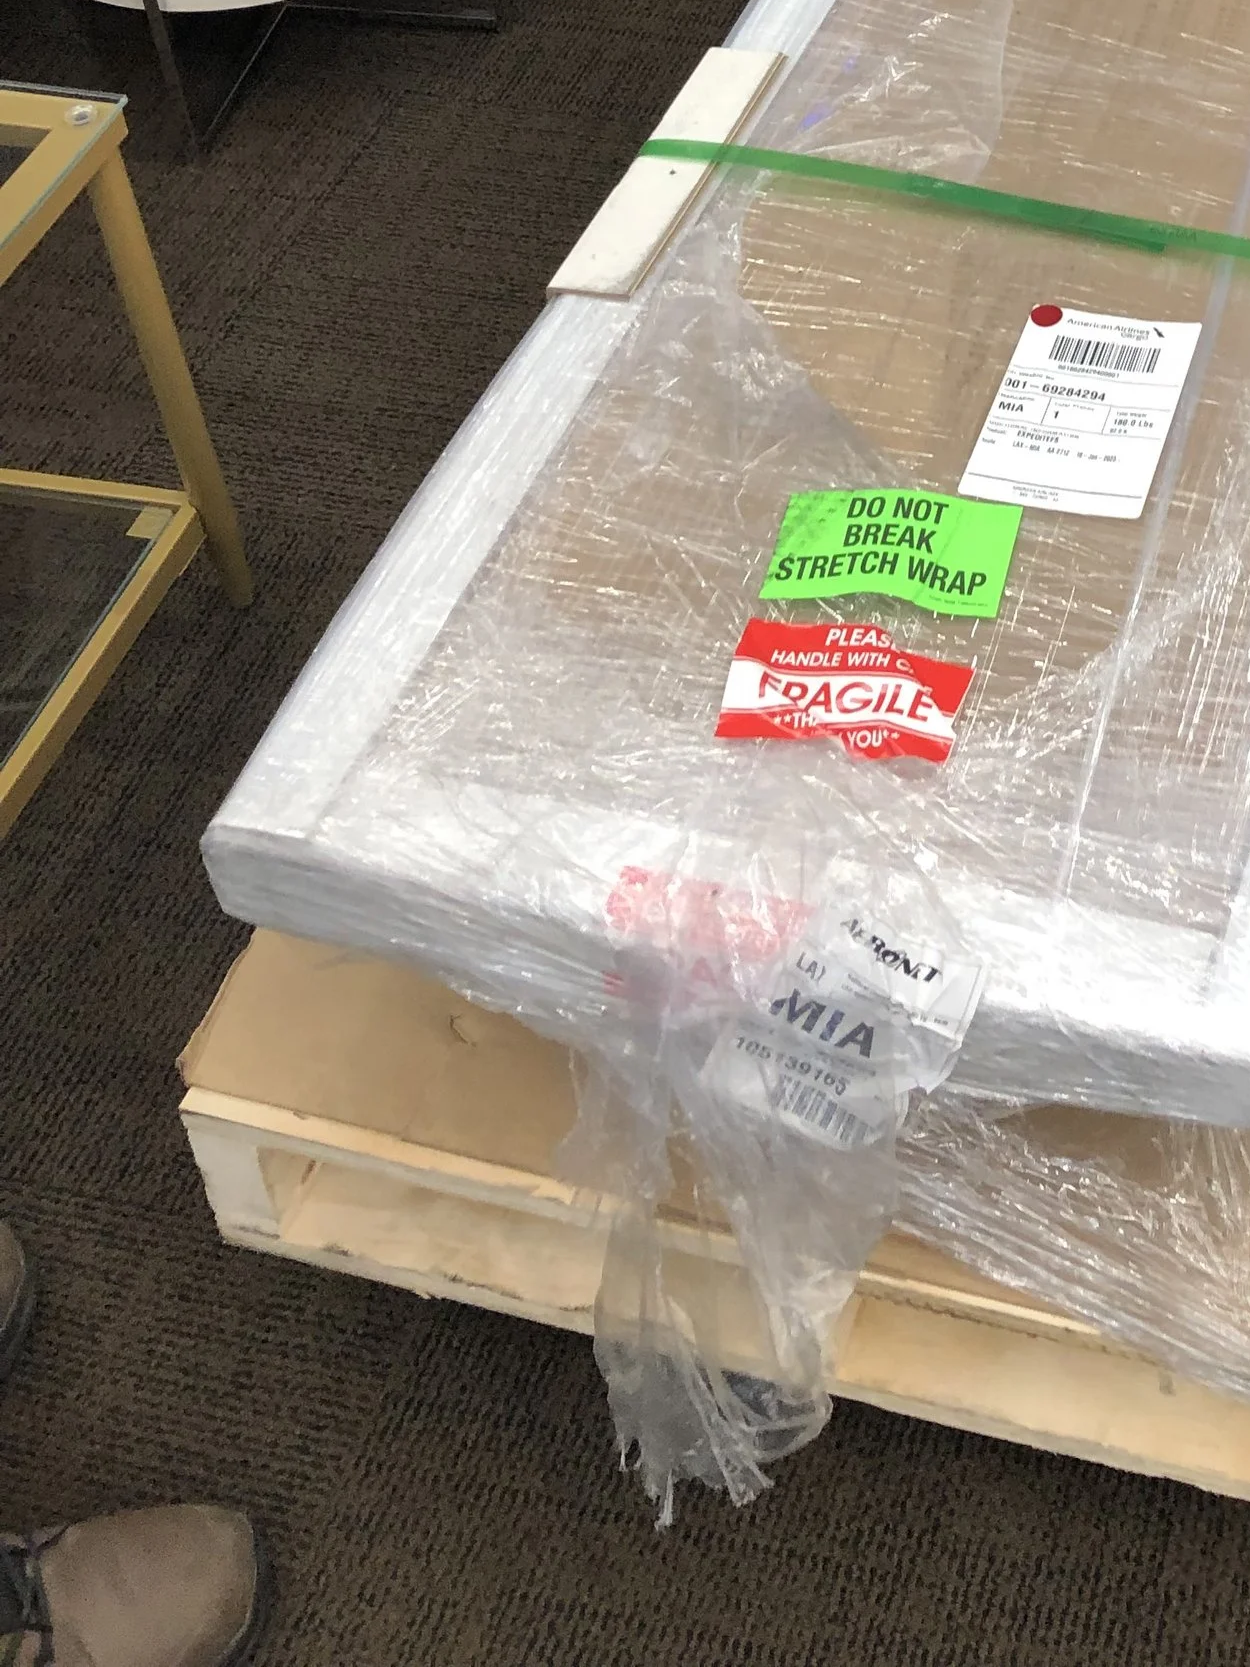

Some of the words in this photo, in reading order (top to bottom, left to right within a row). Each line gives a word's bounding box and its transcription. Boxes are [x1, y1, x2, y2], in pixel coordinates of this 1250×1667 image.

[1067, 318, 1113, 331] American
[1114, 325, 1150, 336] Airlines
[1005, 377, 1028, 390] 001
[1042, 384, 1106, 402] 69284294
[998, 401, 1024, 413] MIA
[1053, 410, 1060, 419] 1
[847, 497, 886, 520] DO
[893, 497, 949, 524] NOT
[843, 523, 936, 554] BREAK
[775, 552, 899, 582] STRETCH
[907, 556, 987, 596] WRAP
[825, 628, 895, 648] PLEAS
[769, 649, 842, 668] HANDLE
[847, 652, 890, 668] WITH
[769, 988, 875, 1059] MIA
